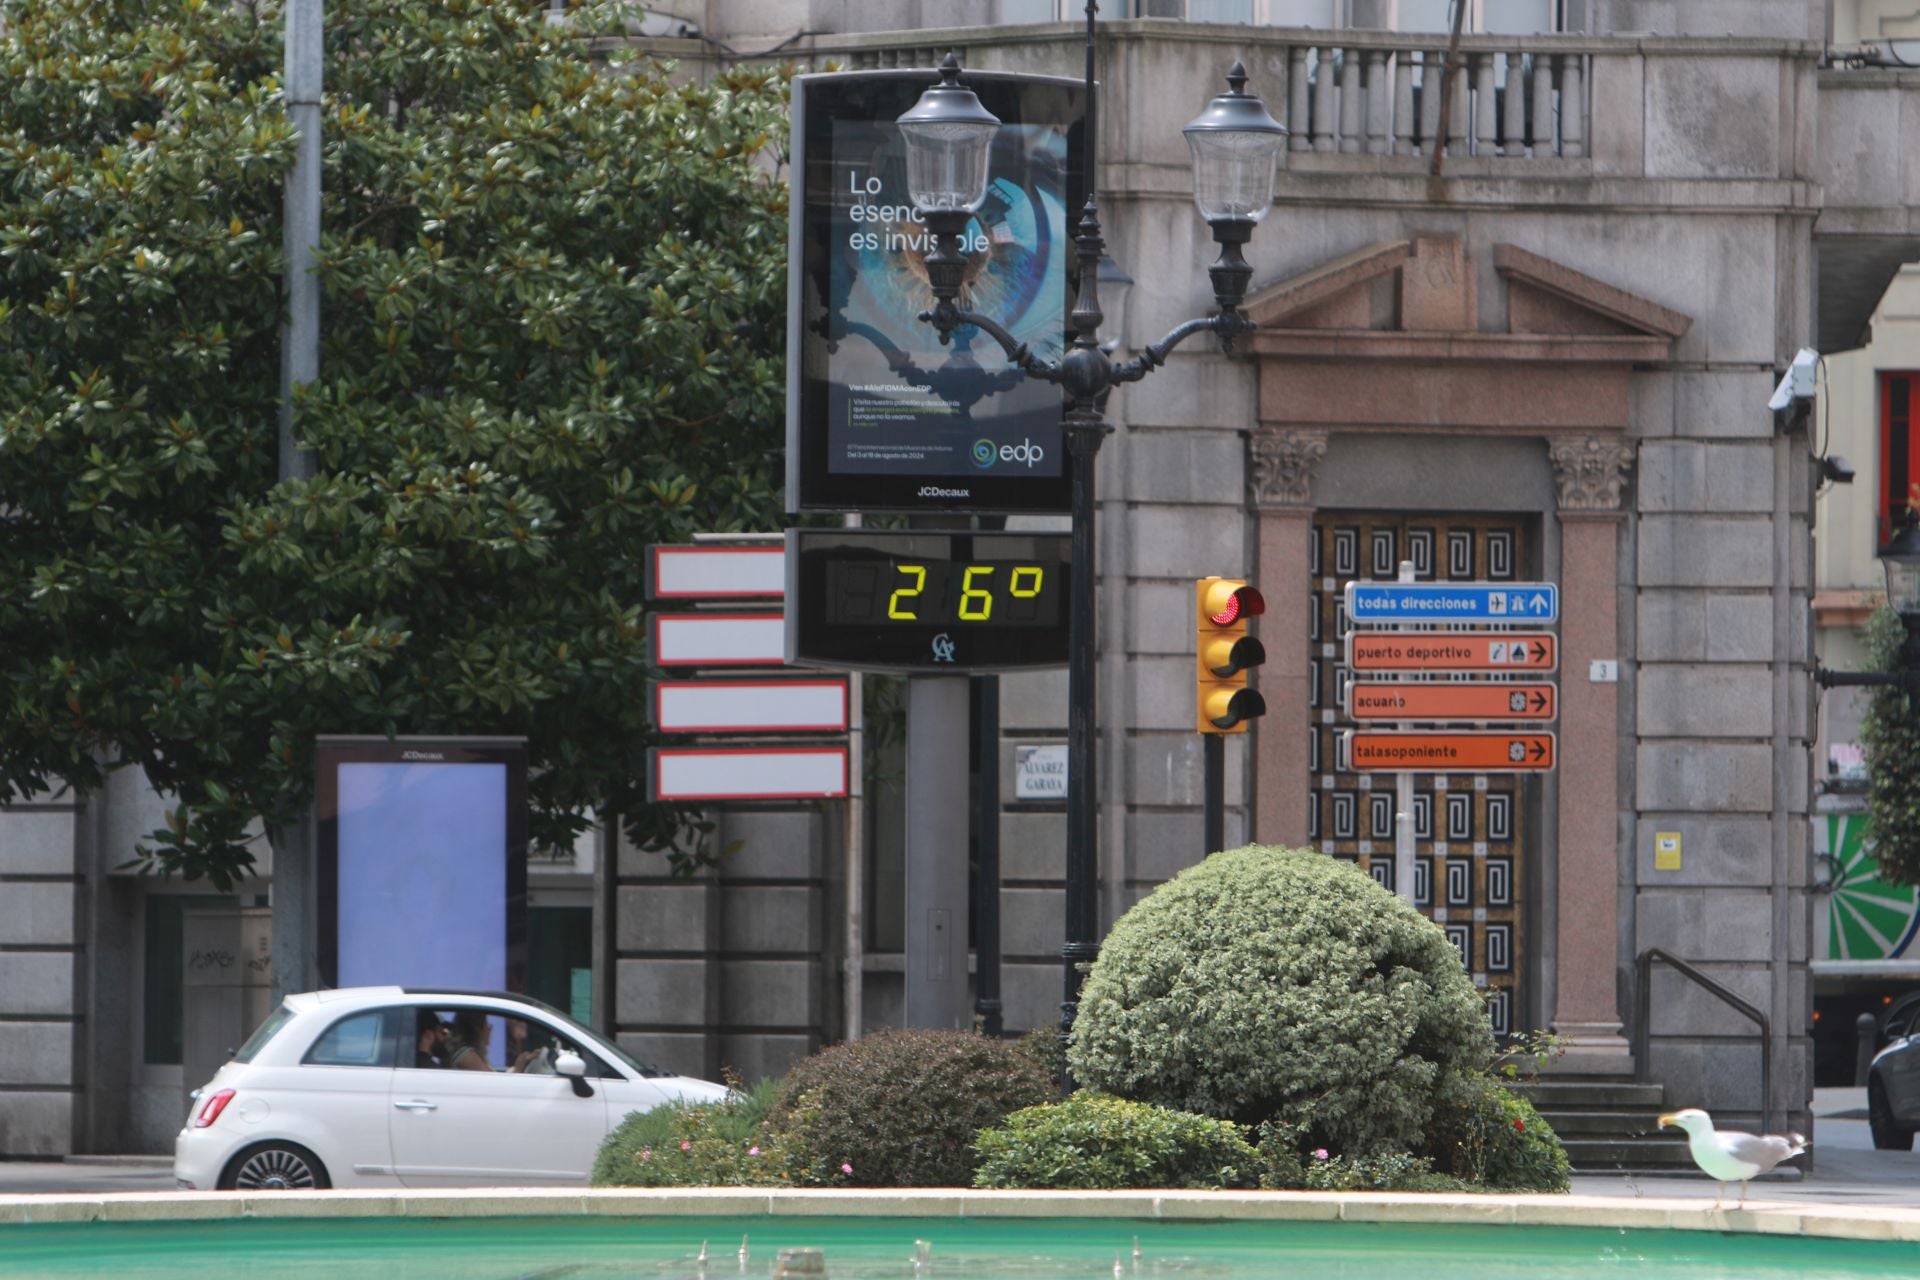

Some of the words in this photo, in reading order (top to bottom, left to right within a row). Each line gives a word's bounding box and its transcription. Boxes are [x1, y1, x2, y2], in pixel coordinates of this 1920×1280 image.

[850, 171, 882, 194] Lo
[849, 232, 878, 250] es
[885, 227, 989, 252] invisle
[999, 438, 1044, 467] edp
[917, 486, 970, 497] JCDecaux
[1358, 596, 1396, 609] todas
[1401, 596, 1477, 609] direcciones
[1357, 646, 1402, 660] puerto
[1406, 646, 1472, 660] deportivo
[1600, 663, 1607, 678] 3
[1357, 696, 1406, 708] acuario
[1357, 745, 1457, 759] talasoponiente
